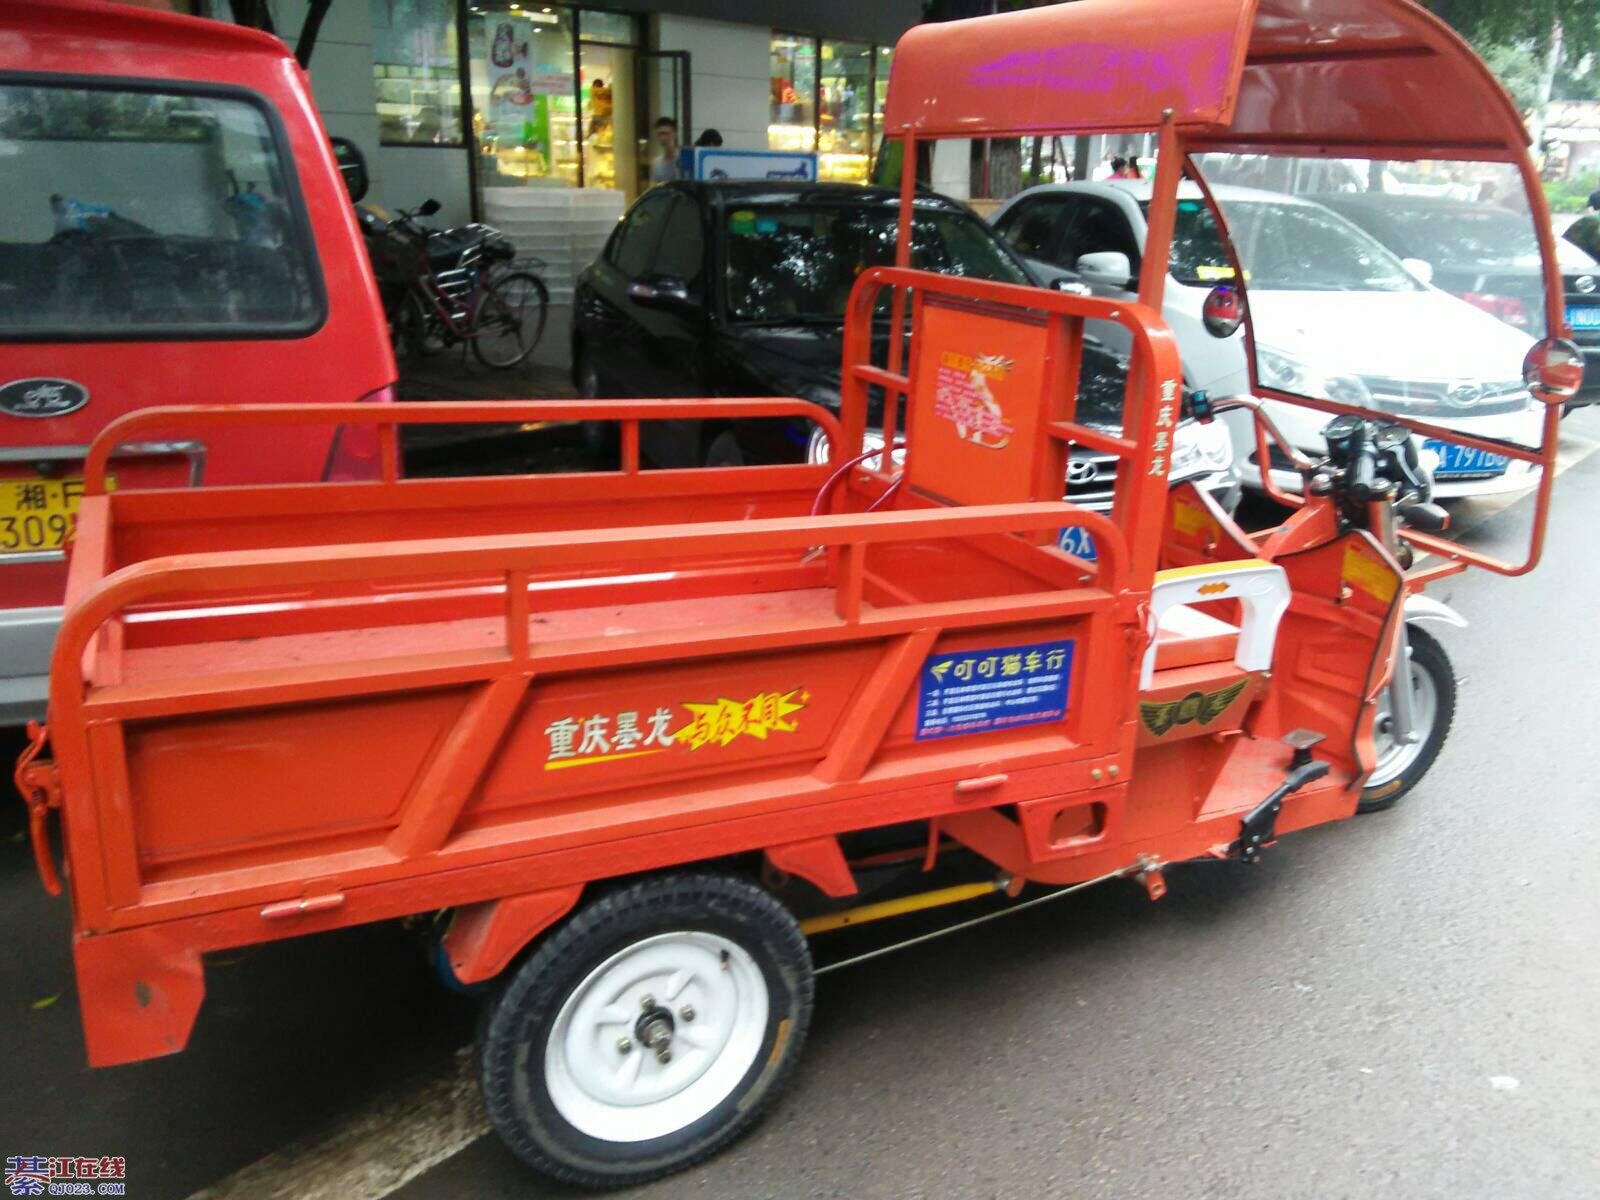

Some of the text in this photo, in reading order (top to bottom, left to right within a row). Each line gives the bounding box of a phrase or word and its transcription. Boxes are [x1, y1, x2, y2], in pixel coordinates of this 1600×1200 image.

[1148, 379, 1178, 476] 重庆墨龙
[953, 649, 1066, 681] 叮叮猫车行
[543, 706, 677, 761] 重庆墨龙
